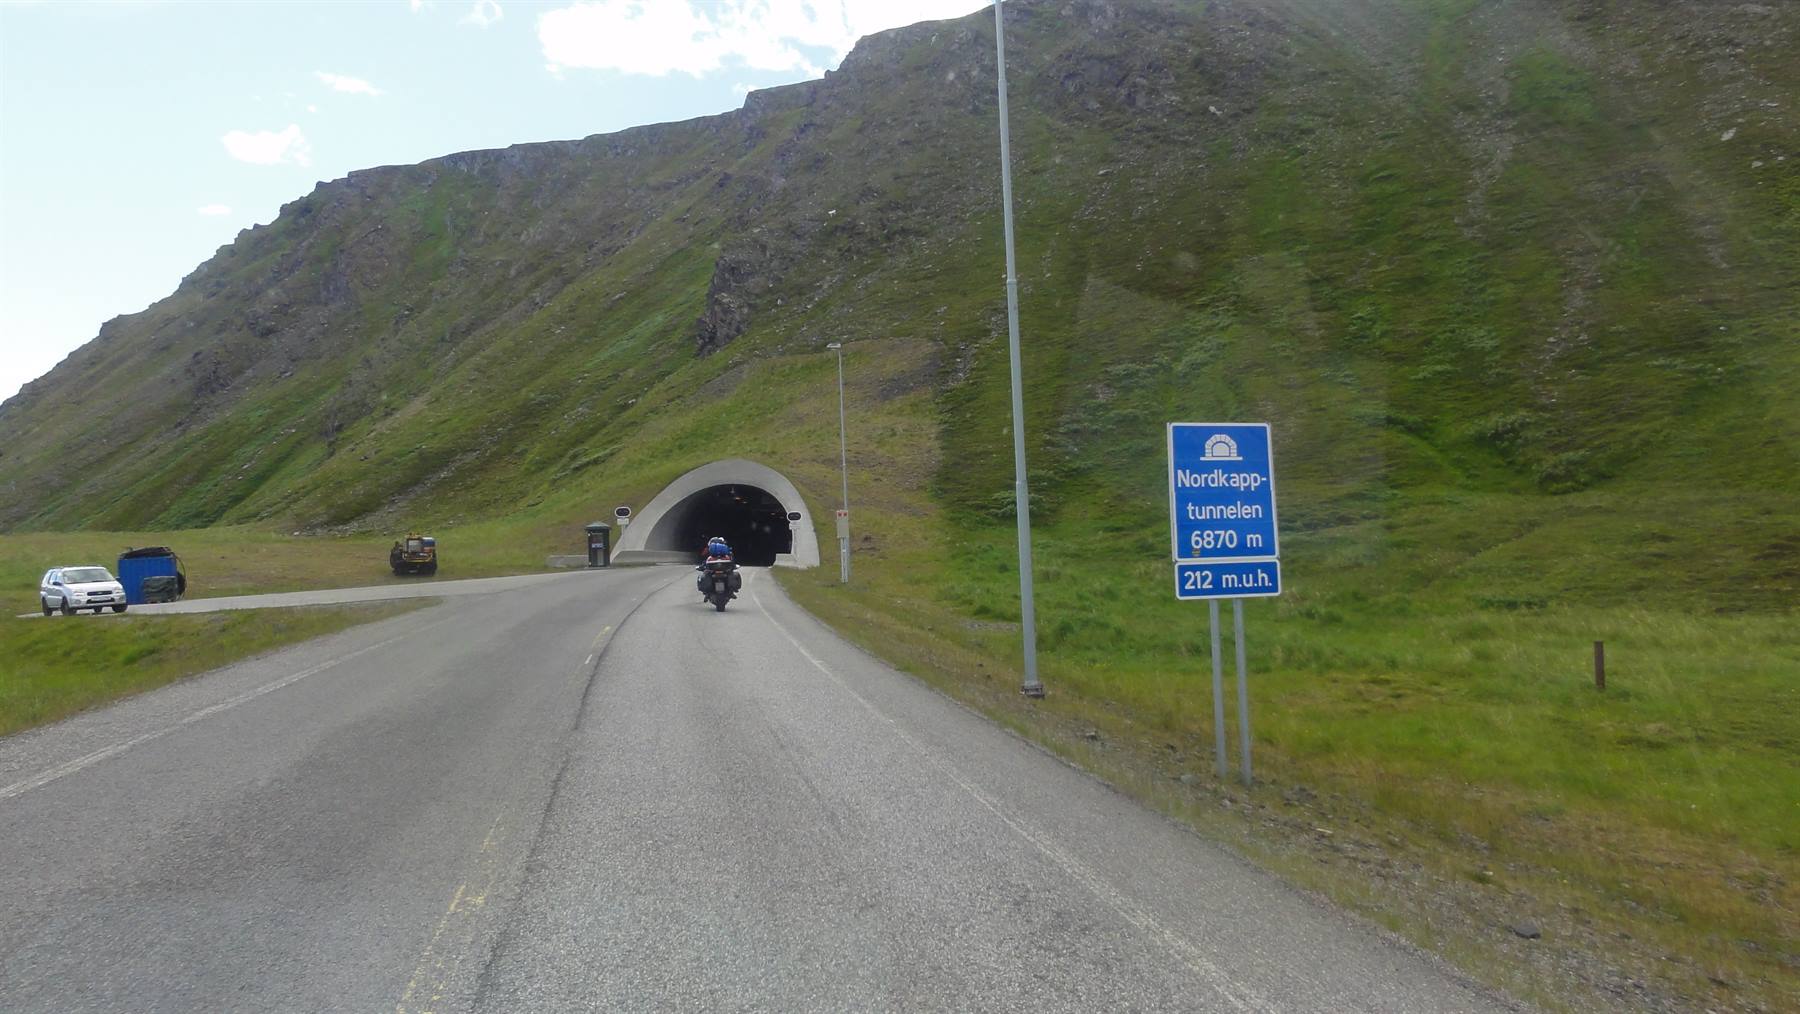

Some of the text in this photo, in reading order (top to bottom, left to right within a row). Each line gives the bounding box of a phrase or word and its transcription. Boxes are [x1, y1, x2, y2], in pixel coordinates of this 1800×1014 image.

[1177, 469, 1267, 491] Nordkapp-
[1187, 501, 1262, 519] tunnelen
[1191, 530, 1263, 549] 6870 m
[1184, 569, 1272, 589] 212 m.u.h.
